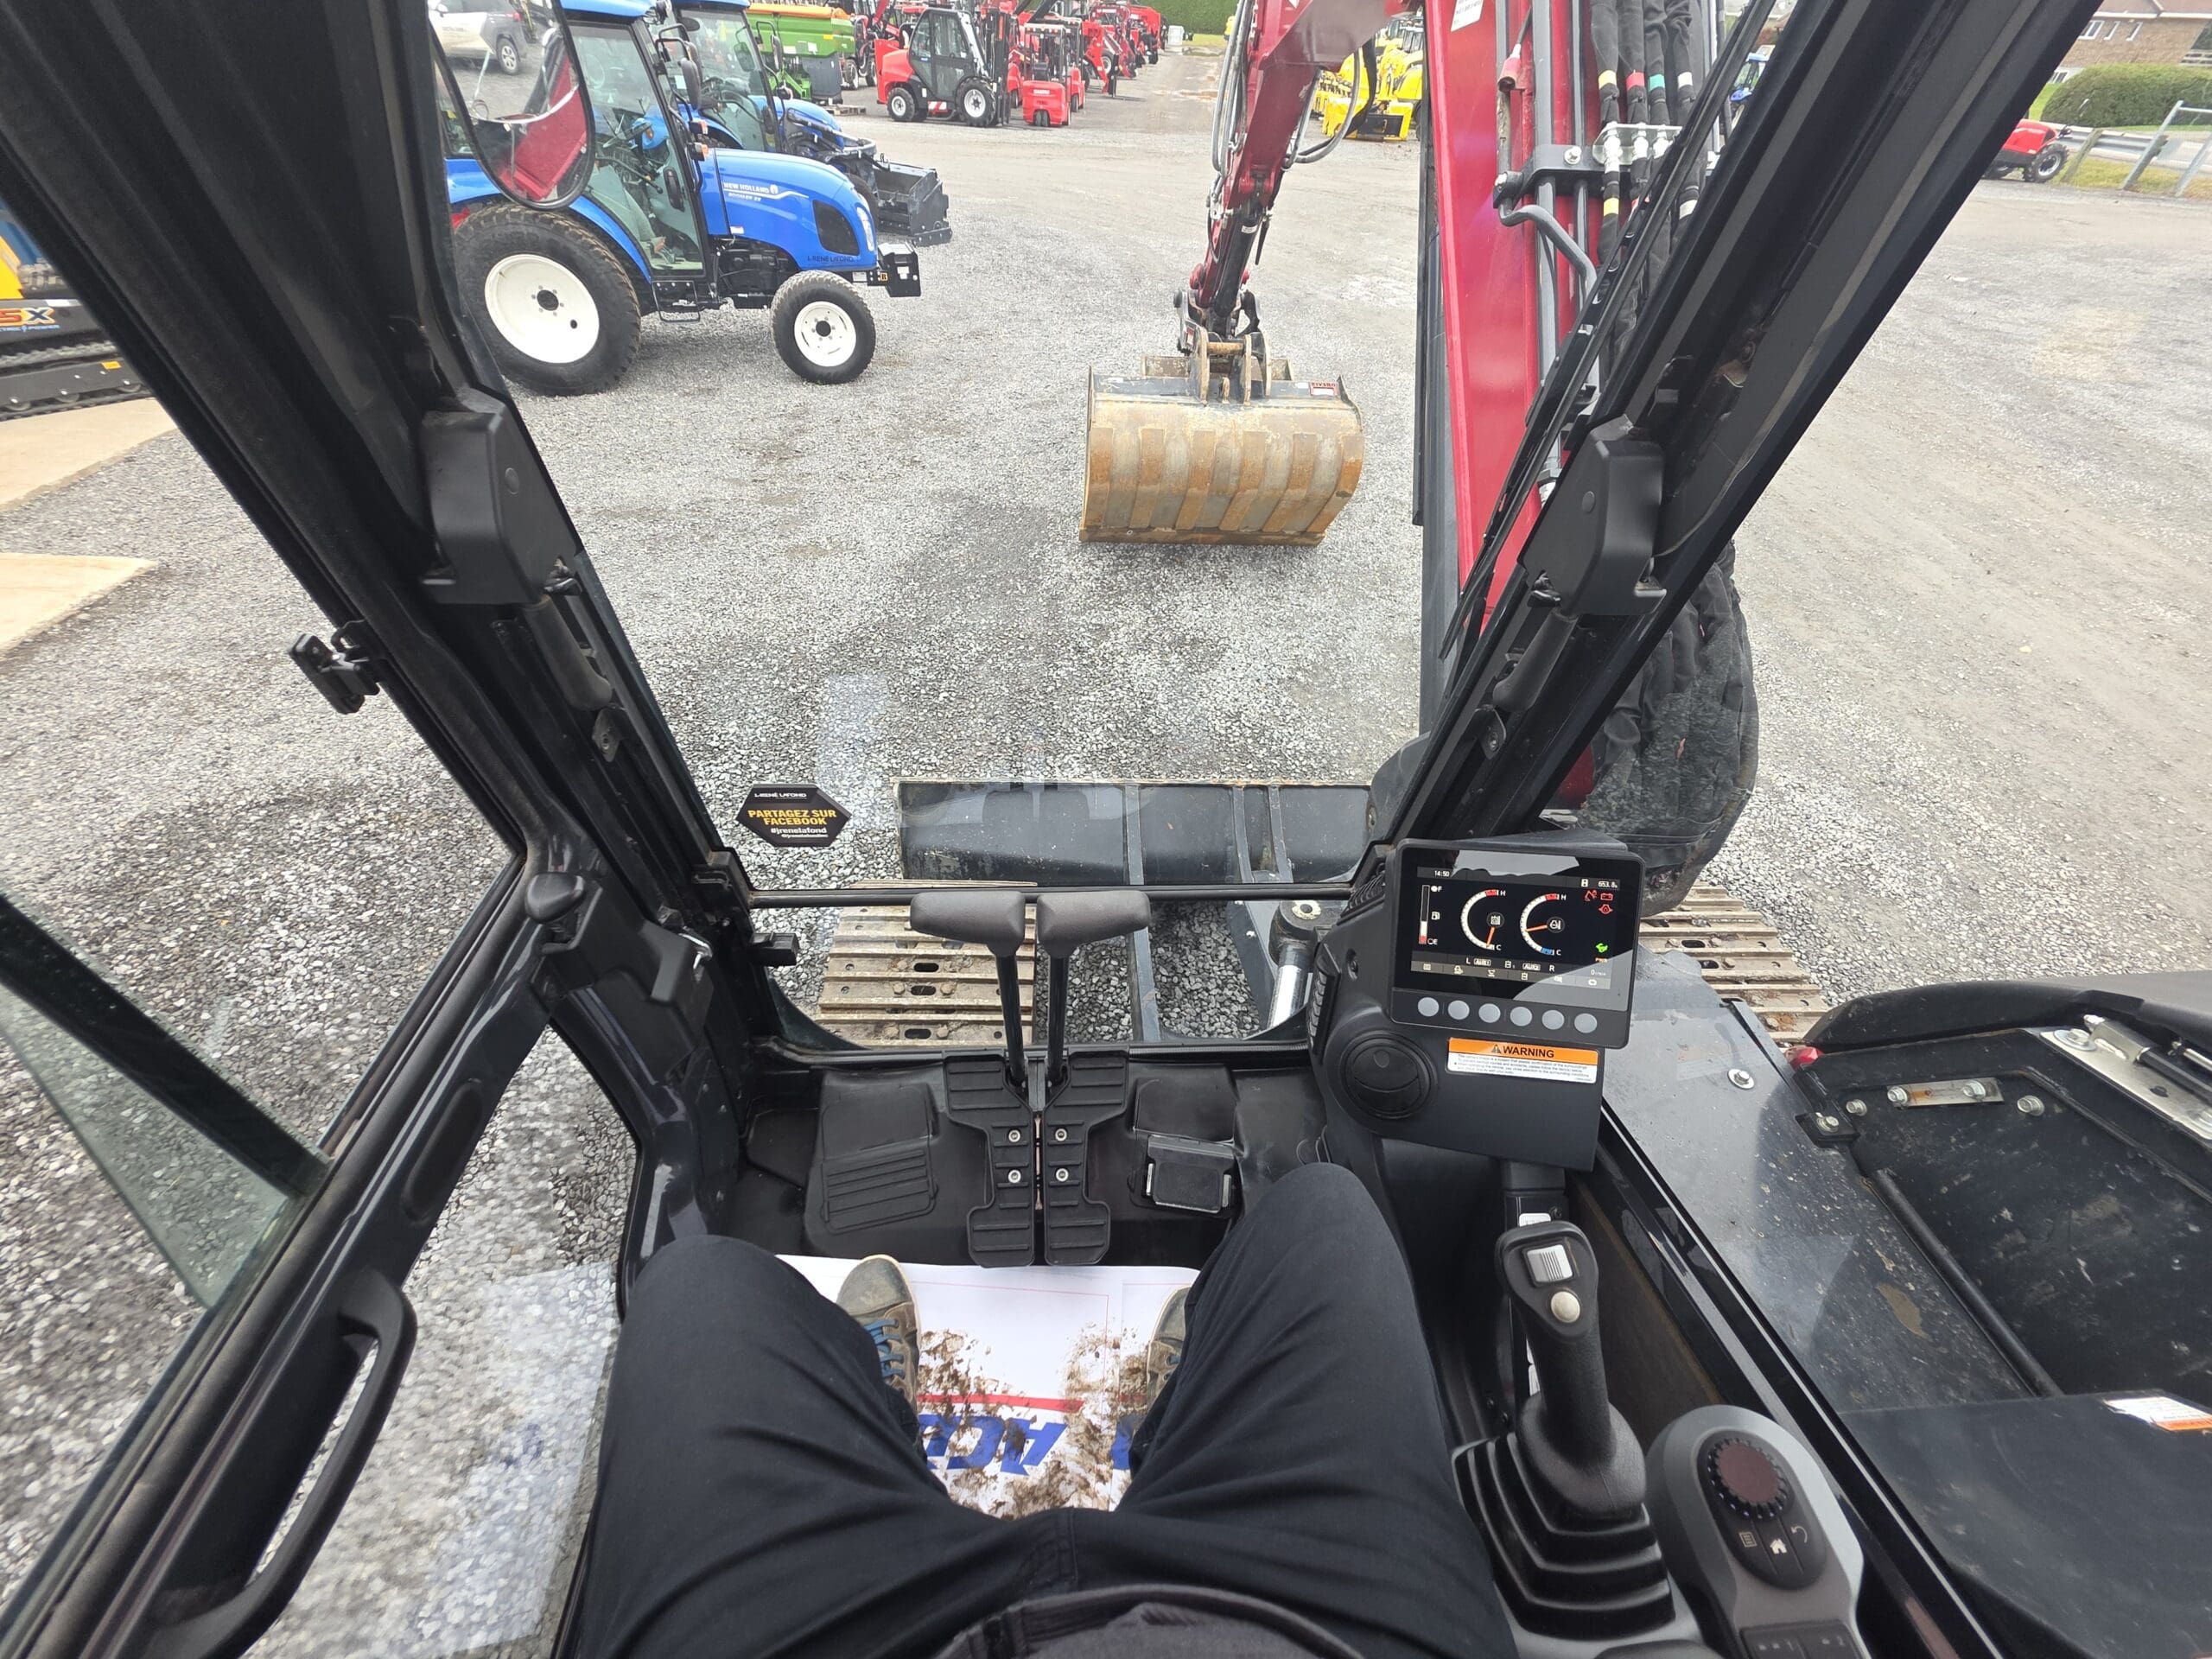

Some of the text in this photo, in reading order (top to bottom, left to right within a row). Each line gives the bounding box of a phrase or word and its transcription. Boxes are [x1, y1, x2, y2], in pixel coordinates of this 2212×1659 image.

[740, 183, 771, 194] HOLLAND
[747, 809, 837, 817] PARTAGEZ SUR
[1503, 1046, 1554, 1058] WARNING
